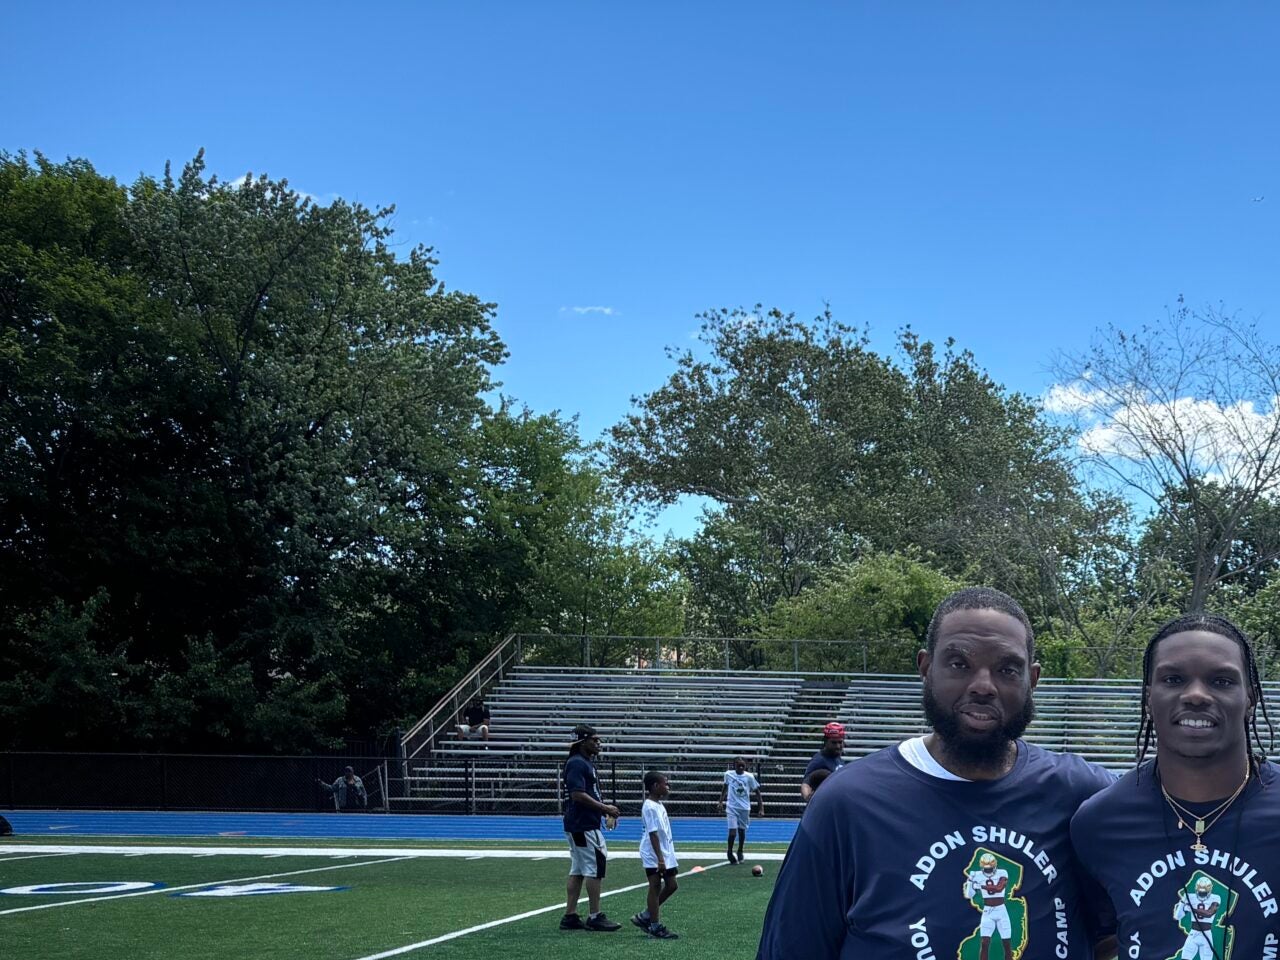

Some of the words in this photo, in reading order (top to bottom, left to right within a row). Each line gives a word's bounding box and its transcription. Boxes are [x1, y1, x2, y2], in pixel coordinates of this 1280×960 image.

[909, 830, 967, 891] ADON
[971, 825, 1058, 884] SHULER
[1129, 850, 1186, 907] ADON
[1193, 849, 1279, 918] SHULER
[1054, 897, 1068, 959] CAMP
